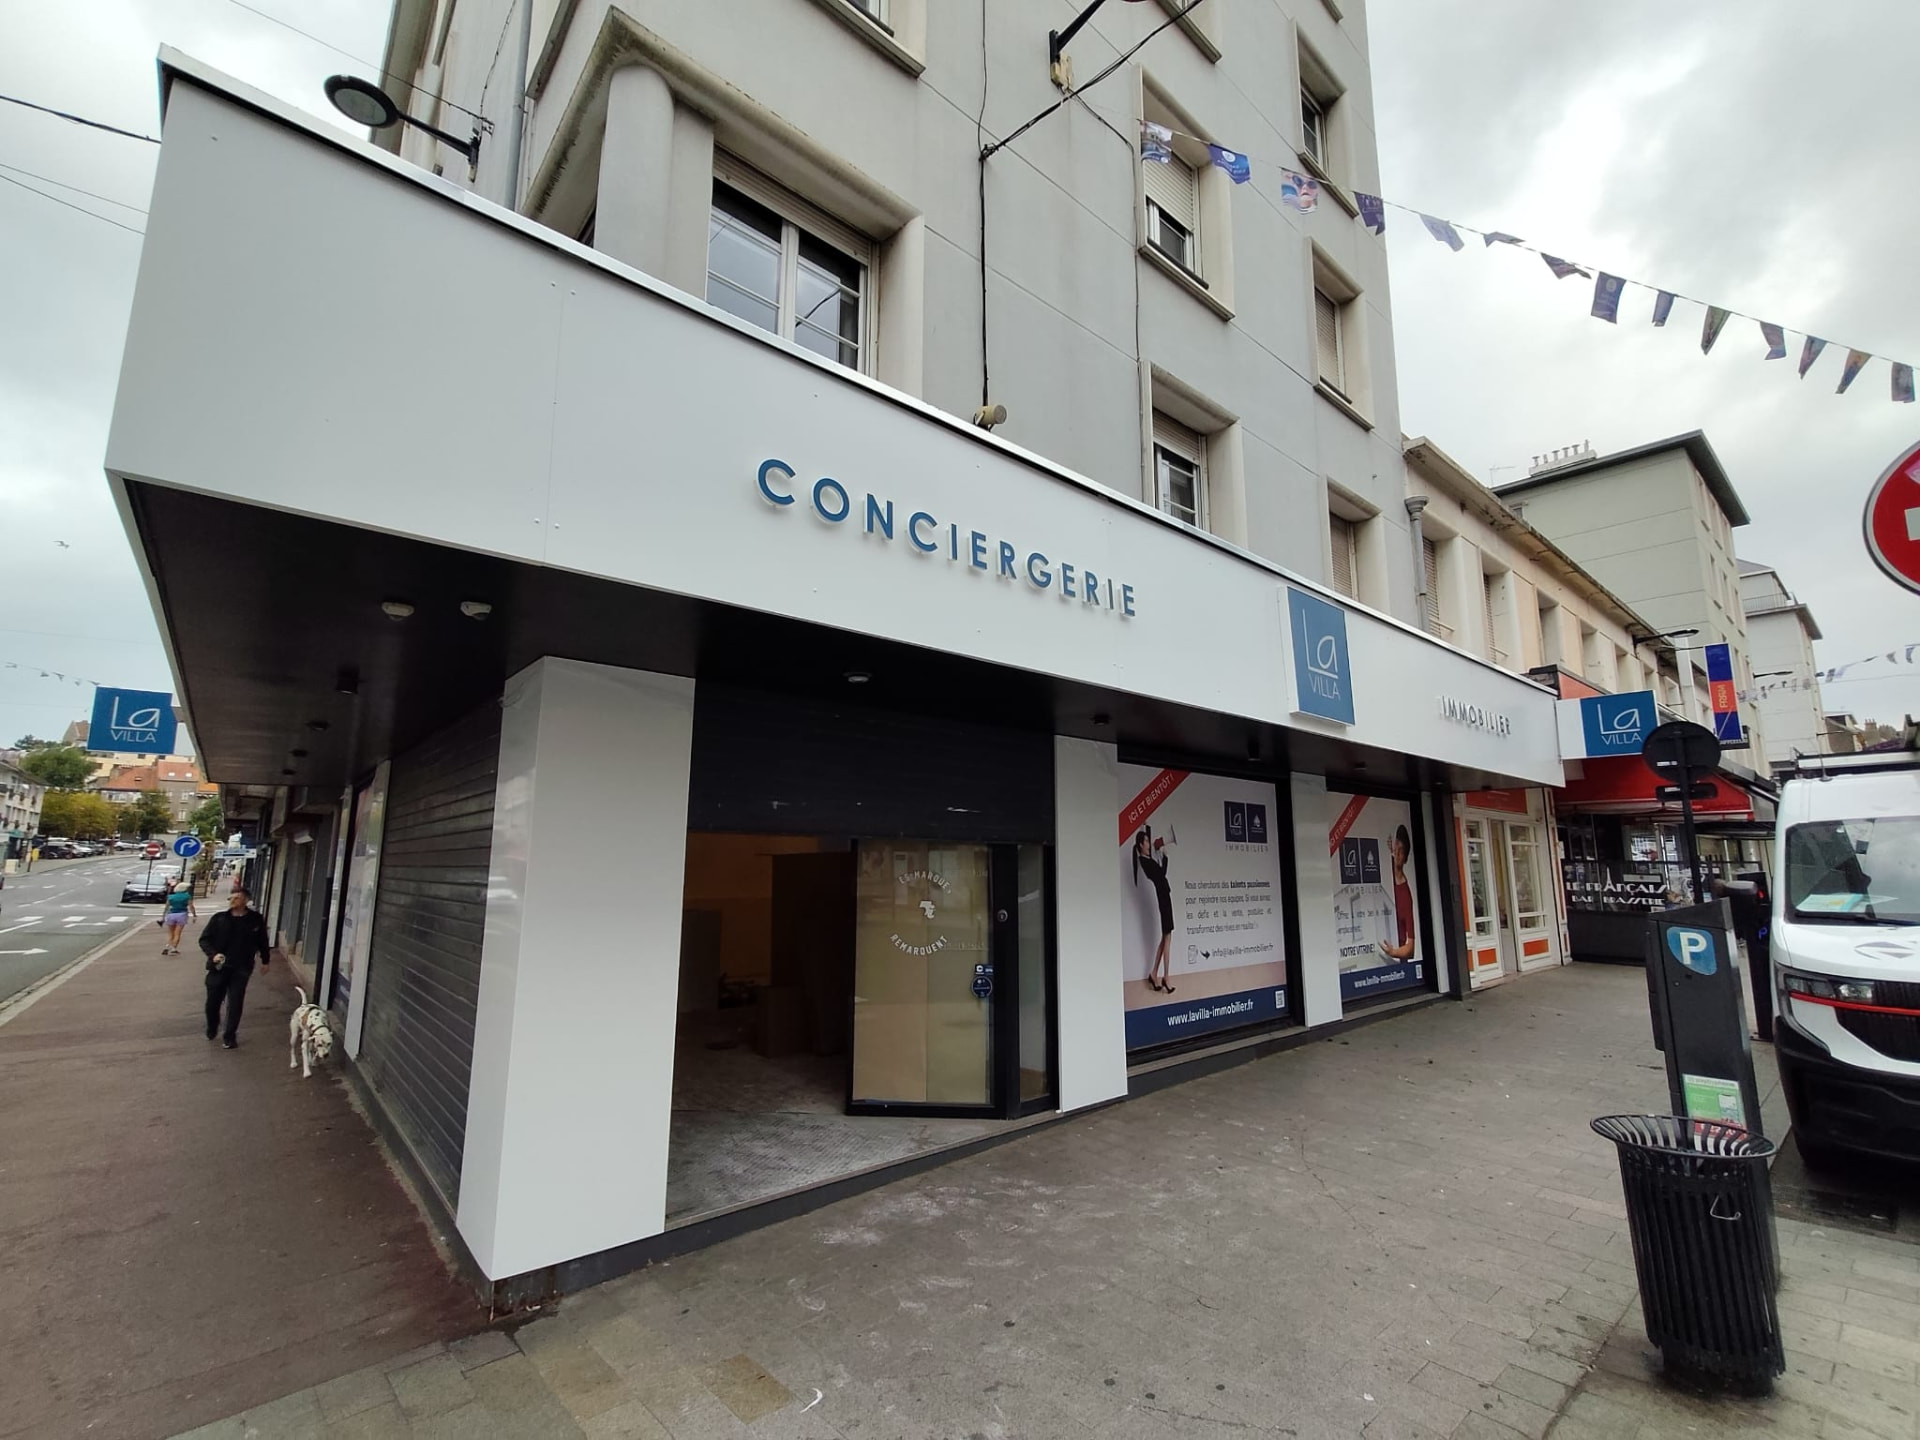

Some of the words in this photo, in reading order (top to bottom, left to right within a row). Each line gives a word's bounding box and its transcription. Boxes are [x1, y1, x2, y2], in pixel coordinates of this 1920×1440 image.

[756, 458, 1136, 617] CONCIERGERIE
[1302, 608, 1338, 680] La
[1308, 671, 1341, 701] VILLA
[110, 696, 160, 732] La
[1441, 695, 1511, 735] IMMOBILIER
[1597, 704, 1641, 734] La
[110, 729, 156, 743] VILLA
[1601, 733, 1642, 746] VILLA
[1128, 811, 1139, 824] ICI
[1137, 801, 1147, 815] ET
[1228, 806, 1242, 829] La
[1572, 895, 1594, 903] BAR
[1603, 896, 1665, 906] BRASSERIE
[890, 934, 948, 956] REMARQUENT
[1679, 931, 1707, 966] P
[1167, 998, 1254, 1027] www.lavilla-immobilier.fr
